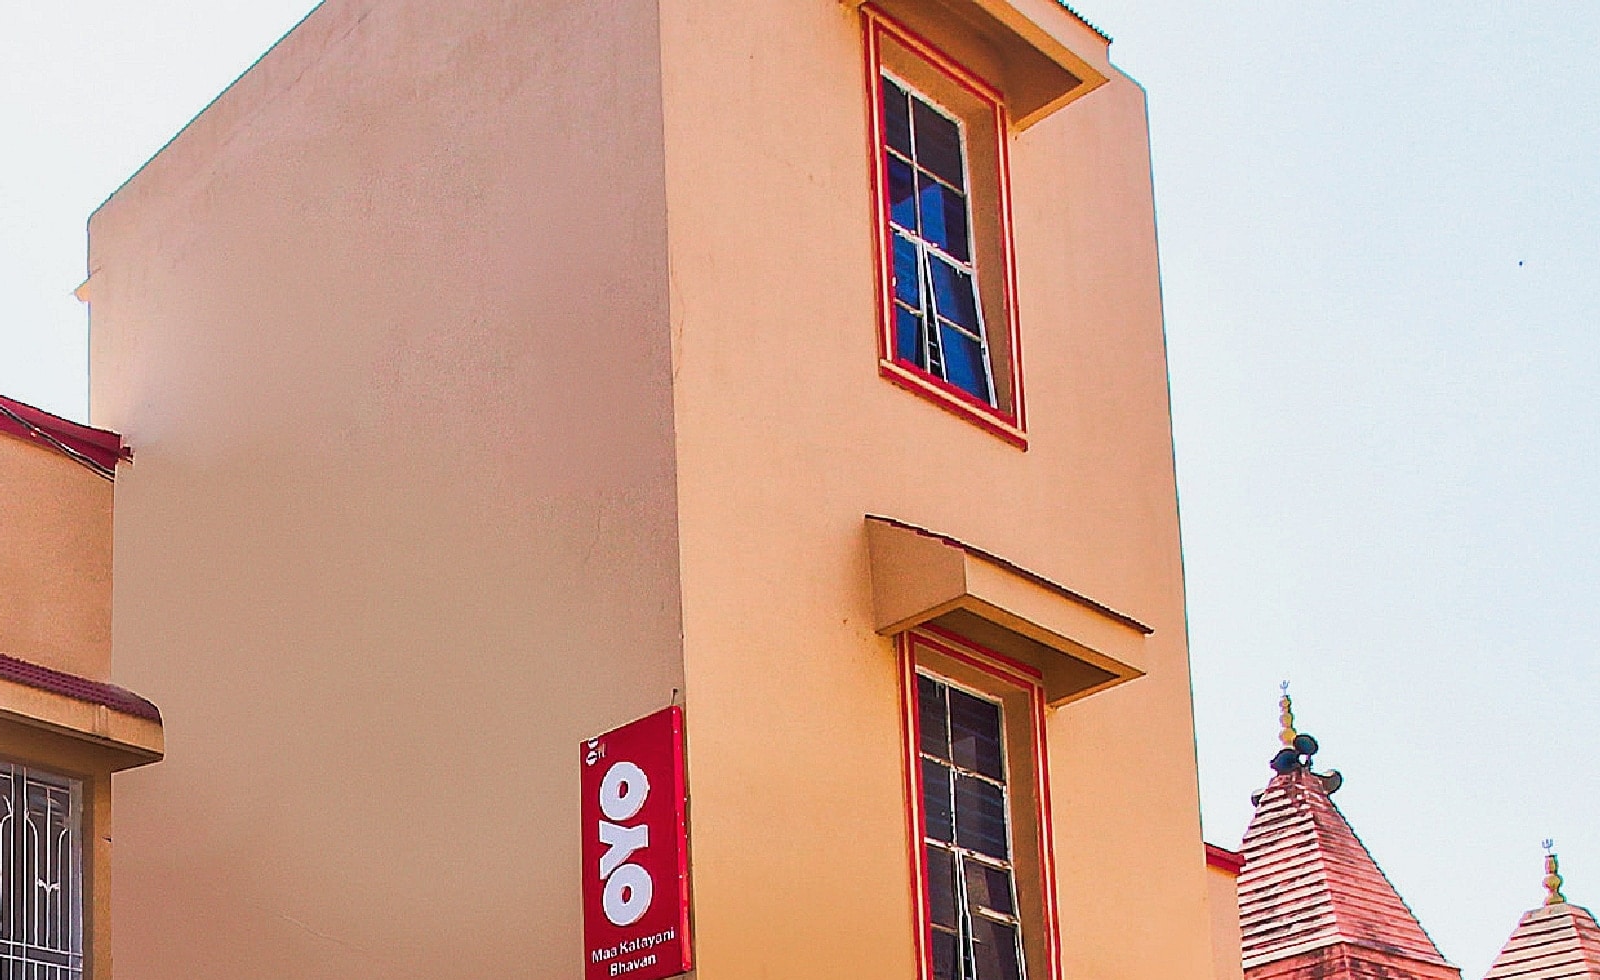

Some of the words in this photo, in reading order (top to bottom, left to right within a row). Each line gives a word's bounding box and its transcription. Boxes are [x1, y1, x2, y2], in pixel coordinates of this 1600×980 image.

[599, 761, 653, 926] OYO
[592, 947, 618, 963] Maa
[610, 954, 657, 977] Bhavan
